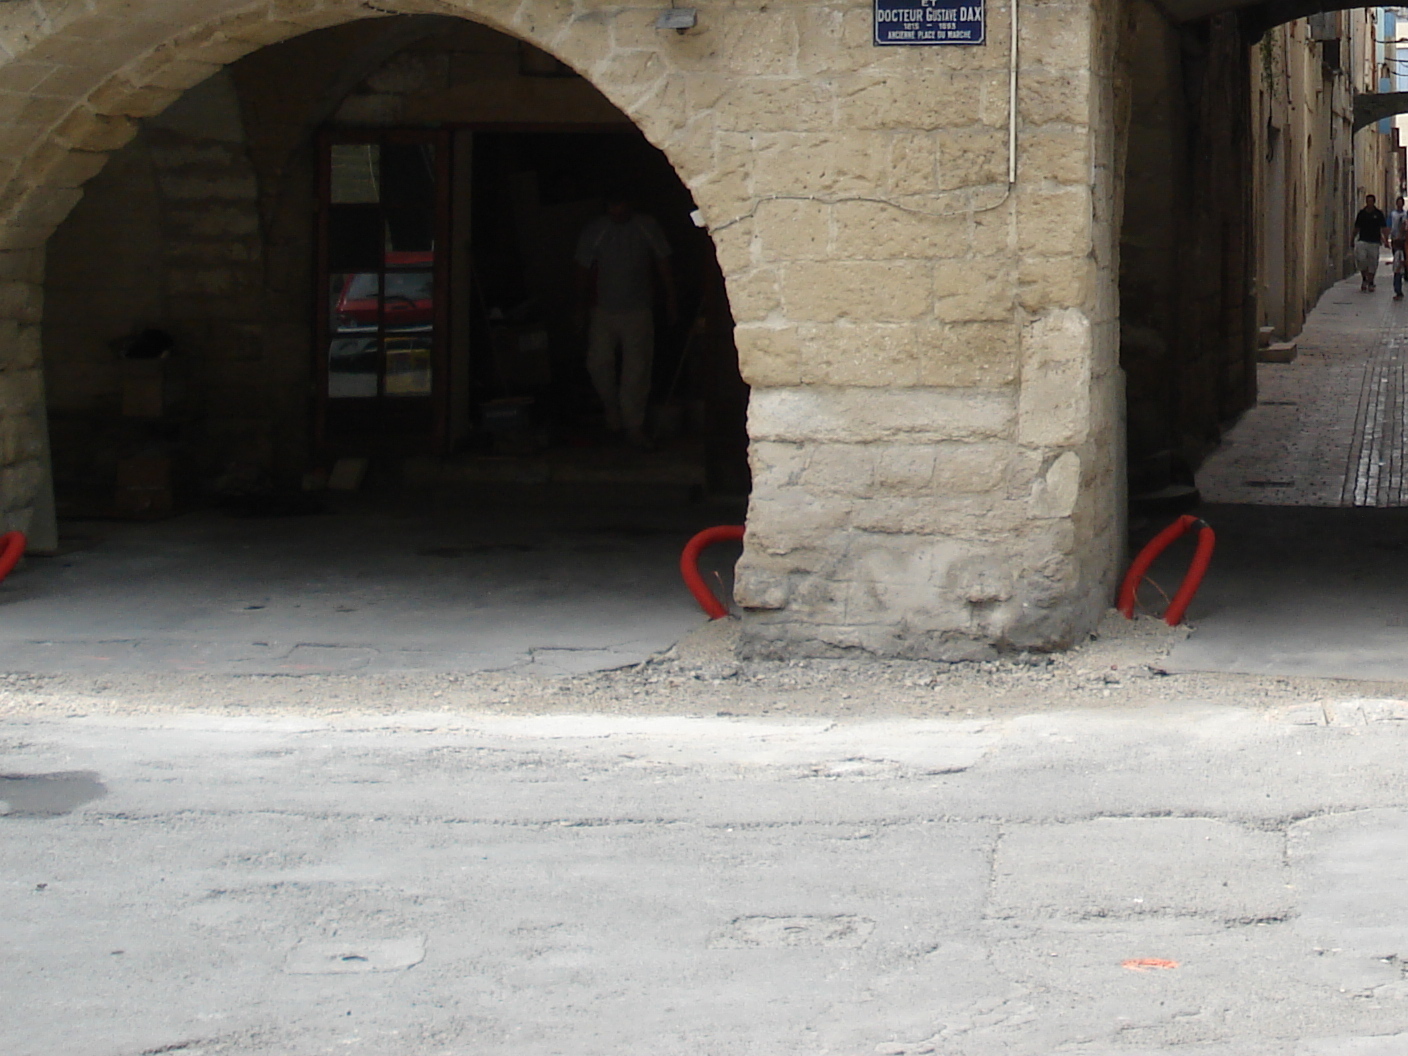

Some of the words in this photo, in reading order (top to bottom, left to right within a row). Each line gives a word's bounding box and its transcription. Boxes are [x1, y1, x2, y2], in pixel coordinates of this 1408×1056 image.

[878, 9, 924, 22] DOCTEUR
[960, 6, 982, 22] DAX
[887, 30, 915, 39] ANCIENNE
[917, 30, 936, 39] PLACE
[937, 30, 946, 39] DU
